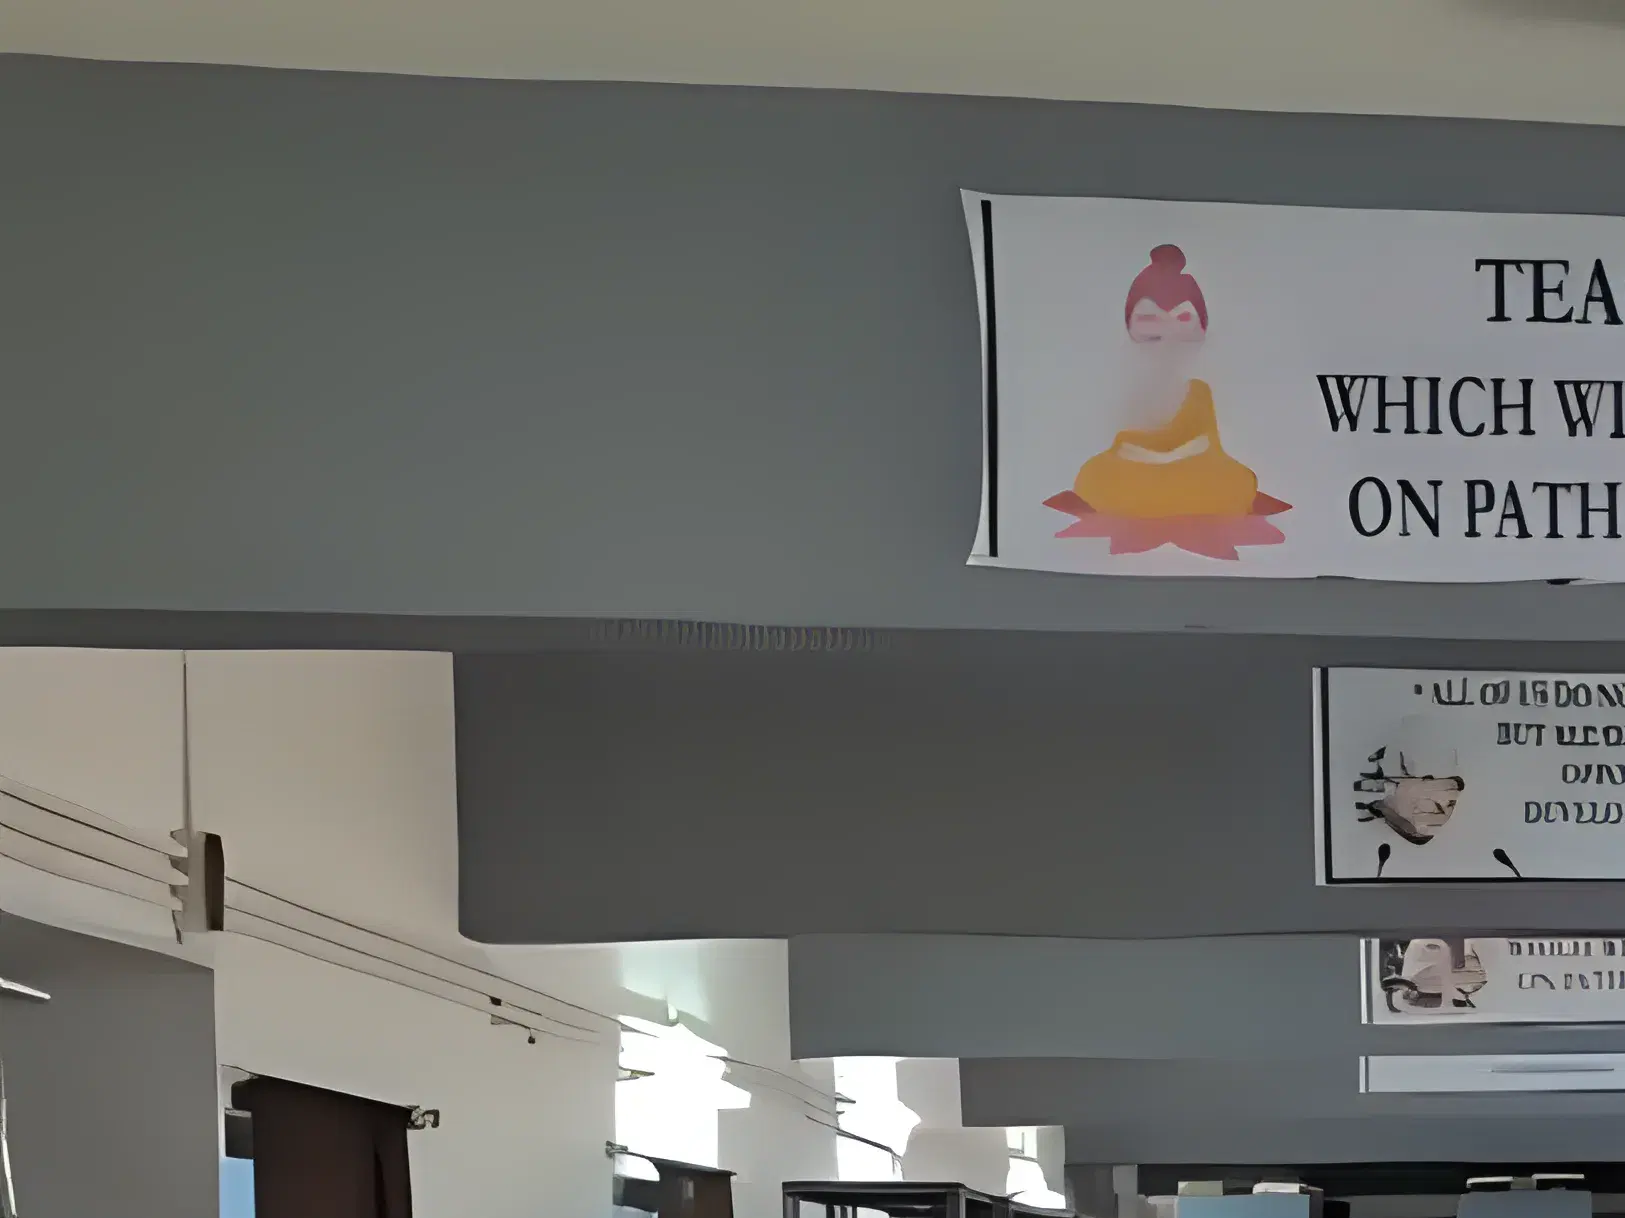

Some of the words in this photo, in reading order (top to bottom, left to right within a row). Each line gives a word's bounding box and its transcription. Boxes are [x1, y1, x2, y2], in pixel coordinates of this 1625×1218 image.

[1316, 375, 1535, 437] WHICH
[1349, 477, 1442, 537] ON
[1464, 480, 1621, 539] PATH
